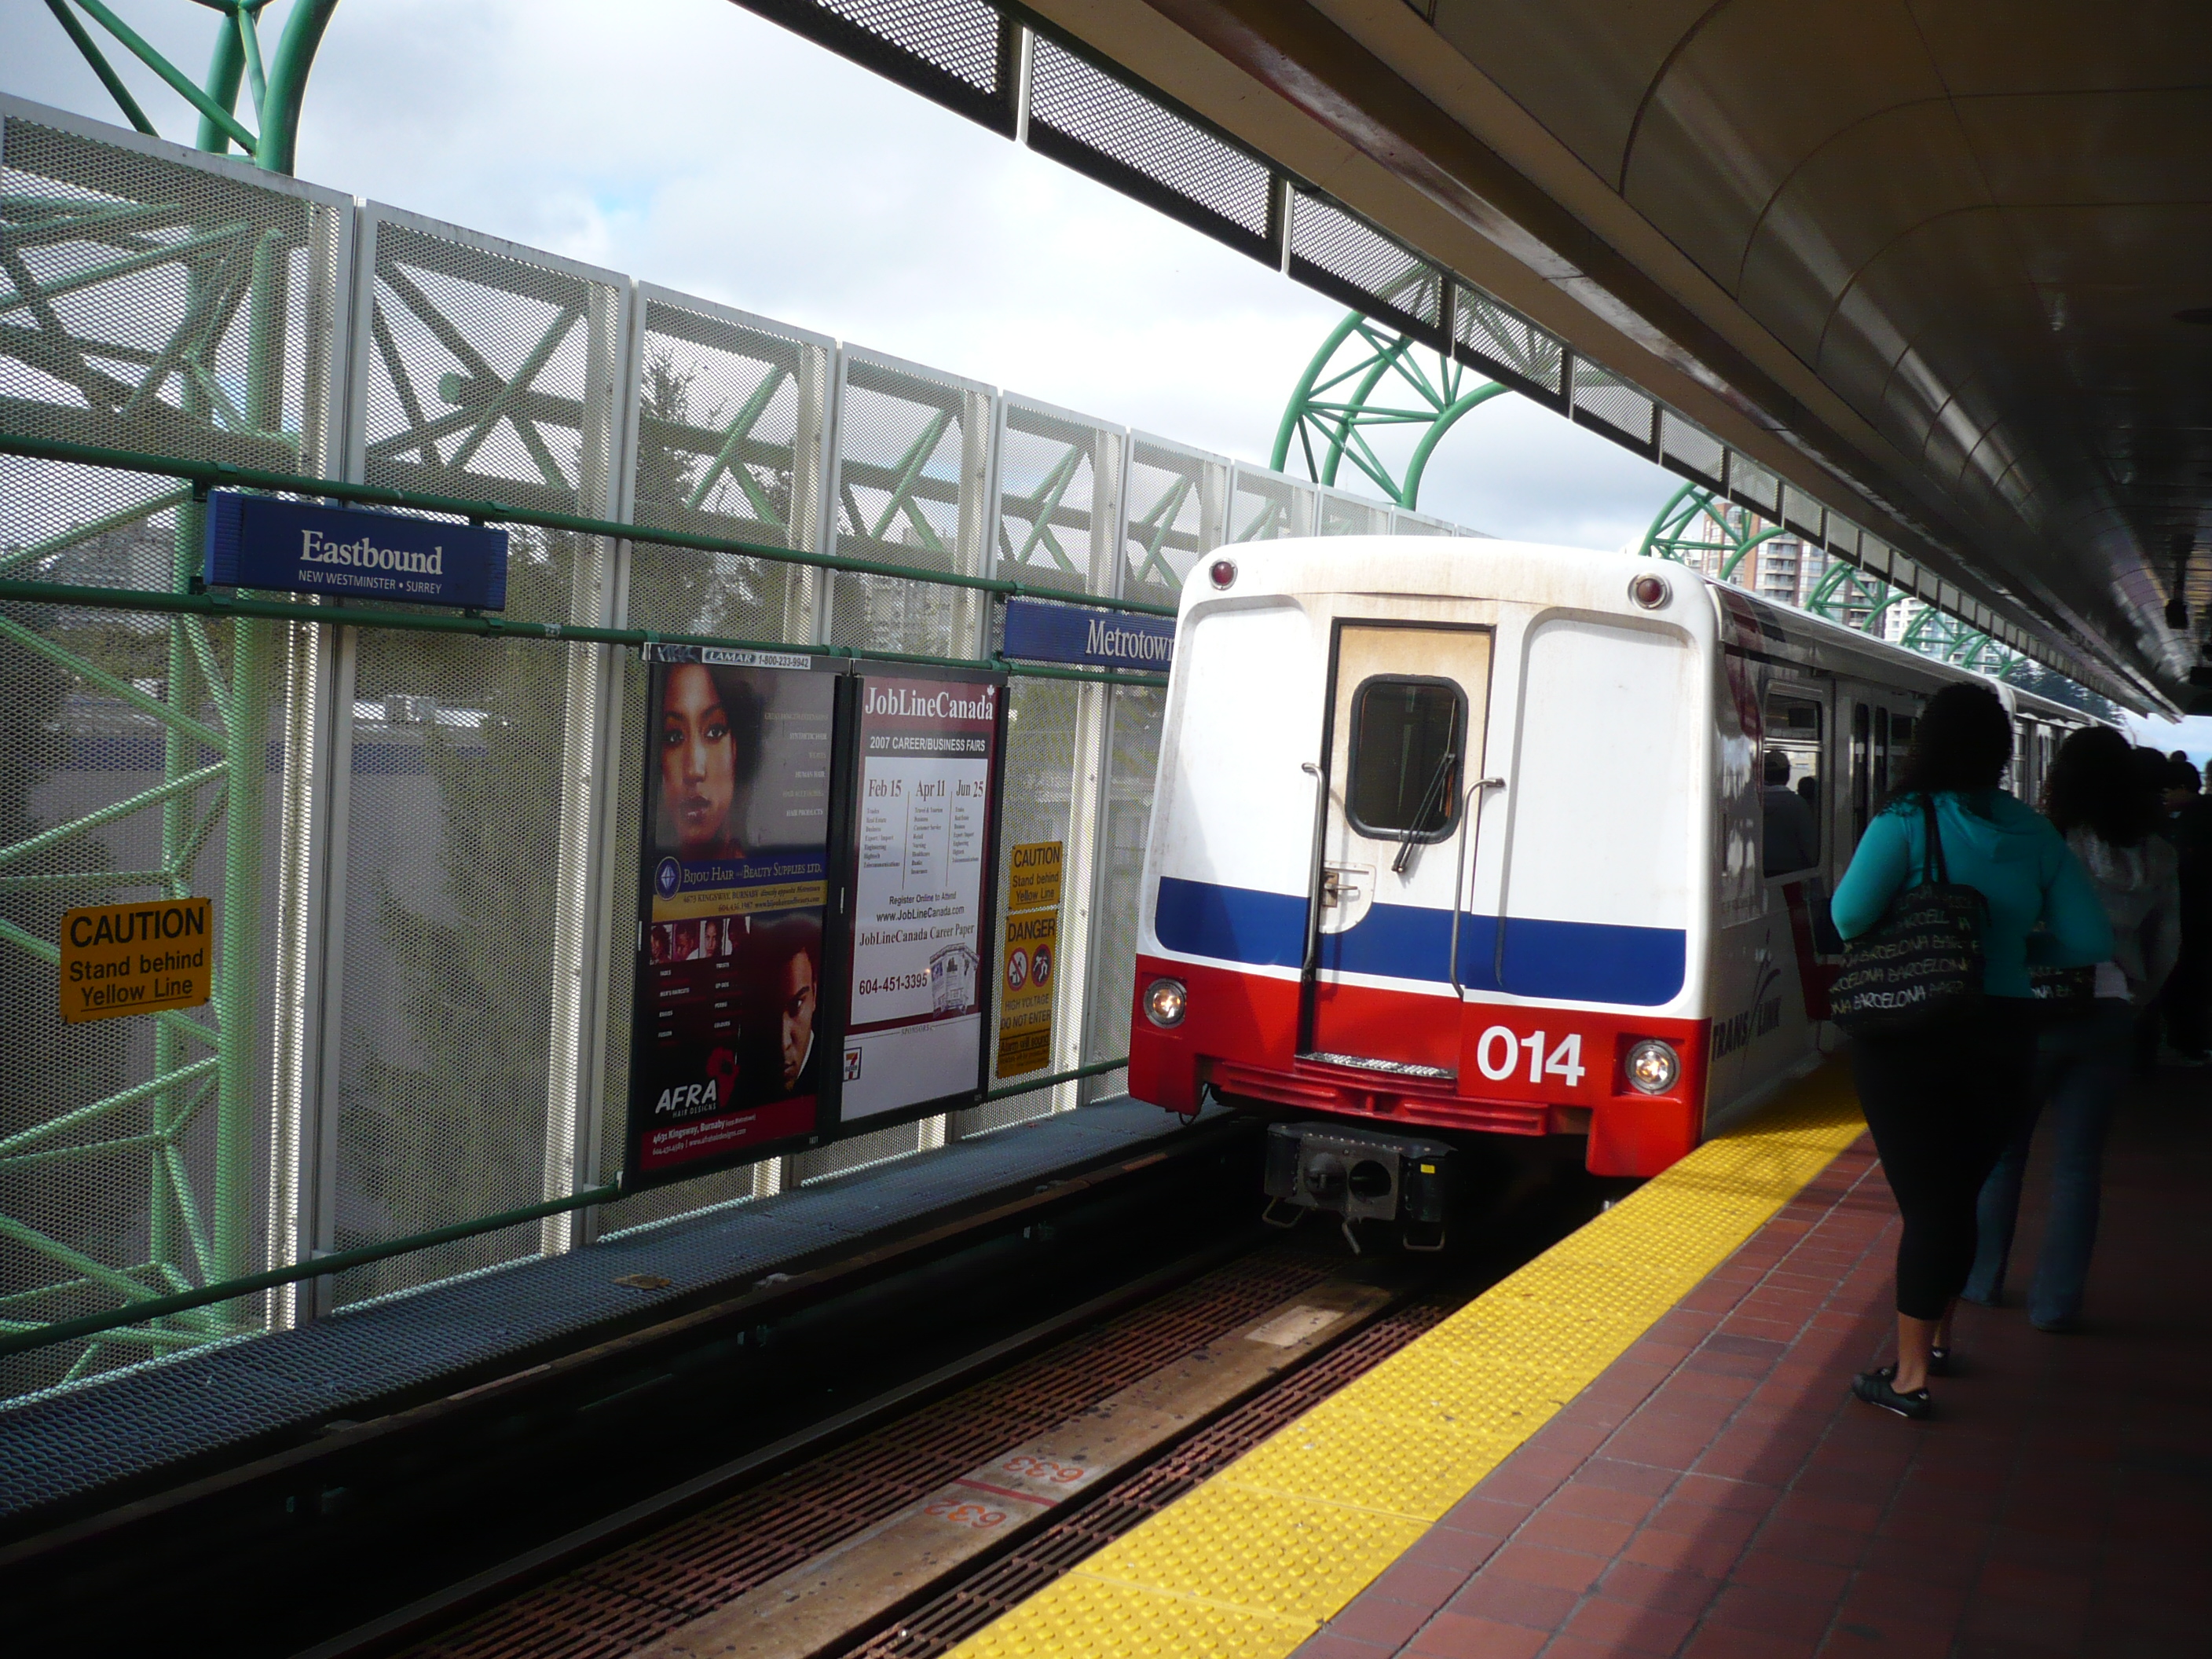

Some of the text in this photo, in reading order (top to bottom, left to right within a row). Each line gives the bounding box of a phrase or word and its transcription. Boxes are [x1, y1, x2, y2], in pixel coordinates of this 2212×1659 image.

[300, 529, 443, 575] Eastbound
[298, 569, 442, 595] NEW WESTMINSTER SURREY
[709, 650, 753, 663] LAMAR
[758, 656, 809, 668] 1-800-233-9942
[866, 687, 994, 720] JobLineCanada
[870, 736, 985, 752] 2007 CAREER/BUSINESS FAIRS
[869, 779, 902, 797] Feb 15
[915, 779, 945, 801] Apr 11
[956, 779, 983, 797] Jun 25
[1014, 846, 1060, 868] CAUTION
[1013, 870, 1059, 888] Stand behind
[732, 889, 759, 899] BURNABY
[889, 891, 956, 906] Register Online to Attend
[1016, 887, 1055, 902] Yellow Line
[877, 906, 965, 923] www.JobLineCanada.com
[70, 906, 204, 948] CAUTION
[859, 923, 975, 947] JobLineCanada Career Paper
[1008, 918, 1056, 943] DANGER
[70, 947, 203, 982] Stand behind
[81, 977, 193, 1006] Yellow Line
[859, 972, 928, 995] 604-451-3395
[1005, 993, 1049, 1011] HIGH VOLTAGE
[1854, 985, 1927, 1009] BARCELONA
[1001, 1009, 1052, 1030] DO NOT ENTER
[1477, 1025, 1585, 1087] 014
[655, 1079, 716, 1114] AFRA
[672, 1101, 716, 1119] HAIR DESIGNS
[653, 1133, 668, 1145] 4631
[668, 1125, 700, 1142] Kingsway,
[700, 1119, 726, 1133] Burnaby
